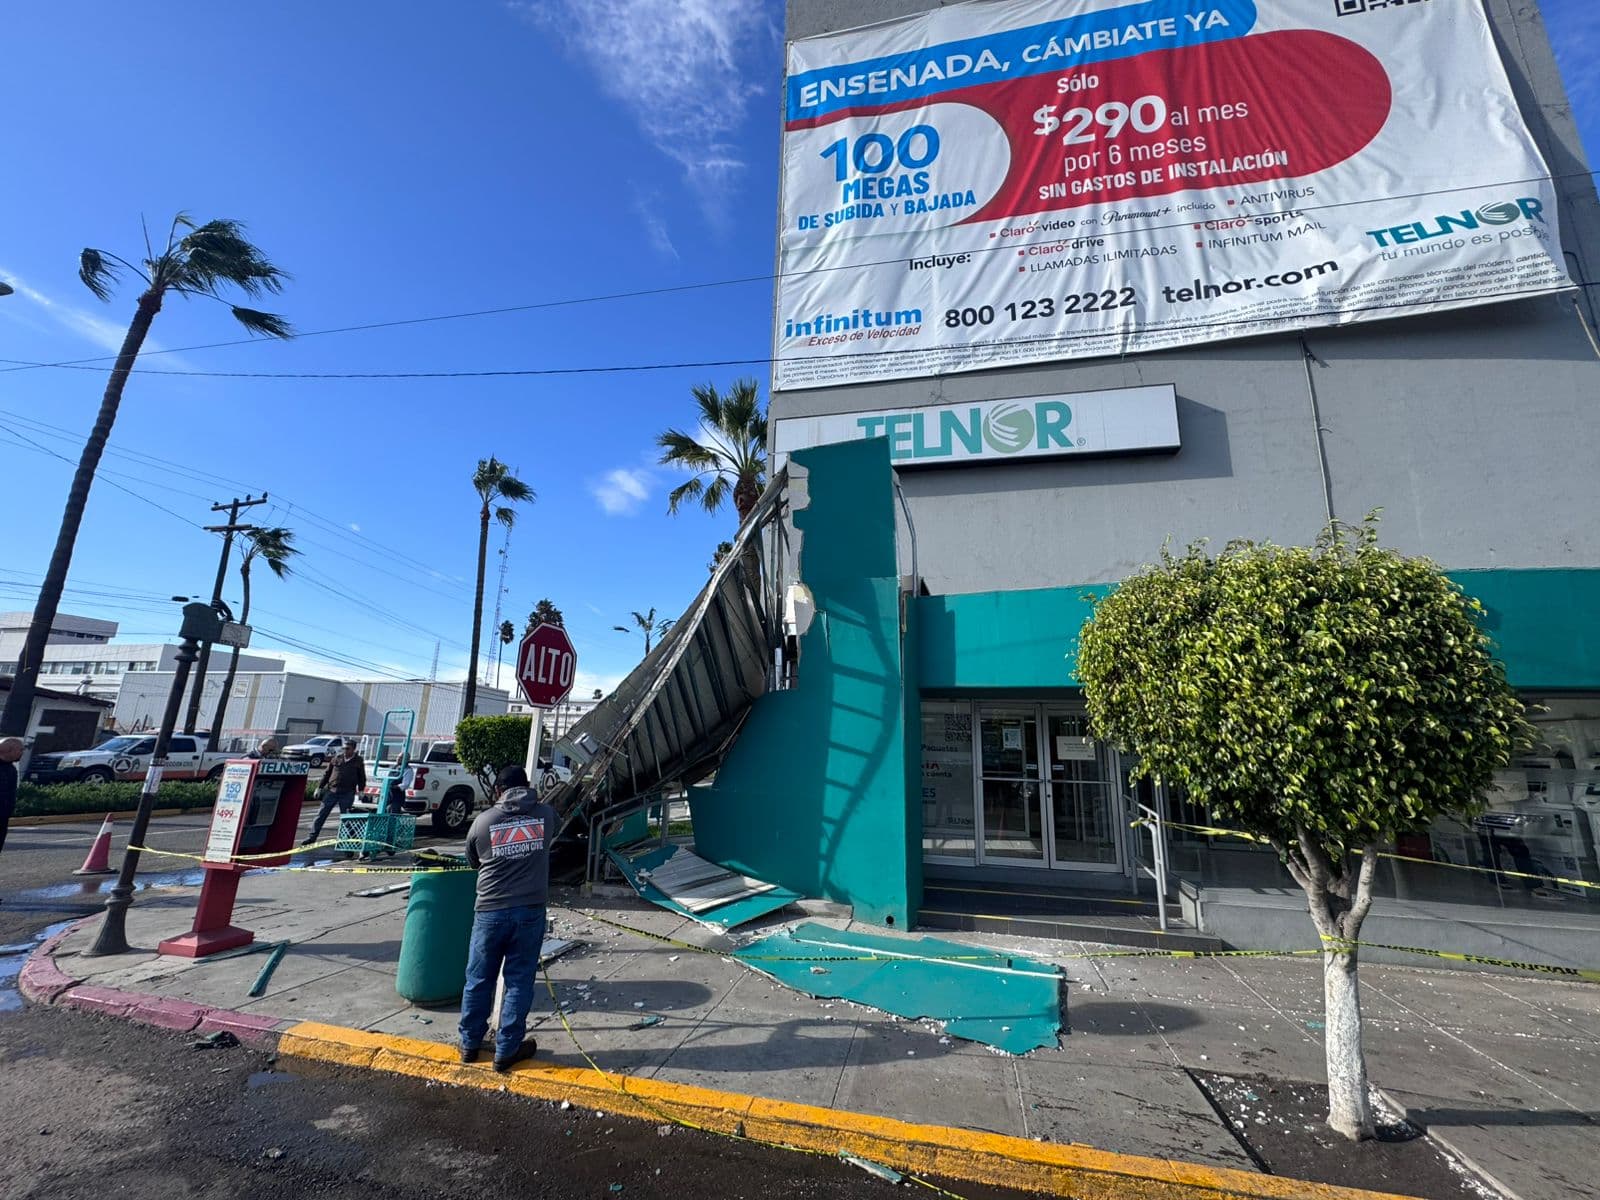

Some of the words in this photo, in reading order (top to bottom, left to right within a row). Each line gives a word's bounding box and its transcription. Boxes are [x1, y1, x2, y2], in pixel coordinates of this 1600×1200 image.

[799, 49, 1011, 108] ENSENADA,
[1021, 17, 1177, 63] CÁMBIATE
[1184, 9, 1230, 33] YA
[1056, 72, 1099, 94] Sólo
[1033, 94, 1168, 146] $290
[1171, 106, 1189, 126] al
[1198, 101, 1249, 123] mes
[819, 123, 941, 182] 100
[1064, 152, 1100, 177] por
[1108, 143, 1122, 164] 6
[1129, 134, 1207, 162] meses
[841, 171, 931, 205] MEGAS
[1038, 181, 1068, 200] SIN
[1071, 174, 1136, 196] GASTOS
[1140, 168, 1163, 186] DE
[1169, 149, 1289, 180] INSTALACIÓN
[798, 214, 819, 231] DE
[825, 202, 884, 227] SUBIDA
[890, 203, 899, 216] Y
[904, 189, 977, 215] BAJADA
[1080, 216, 1098, 227] con
[1100, 205, 1173, 227] Paramount+
[1176, 200, 1217, 212] incluido
[1240, 186, 1316, 206] ANTIVIRUS
[1208, 232, 1284, 250] INFINITUM
[1287, 221, 1327, 241] MAIL
[1366, 197, 1546, 248] TELNOR
[909, 252, 972, 271] Incluye:
[1030, 253, 1099, 273] LLAMADAS
[1103, 245, 1178, 263] ILIMITADAS
[1380, 248, 1398, 261] tu
[1403, 237, 1465, 257] mundo
[1471, 232, 1493, 246] es
[1162, 258, 1340, 304] telnor.com
[785, 307, 923, 338] infinitum
[945, 305, 995, 328] 800
[1004, 297, 1055, 322] 123
[1064, 286, 1137, 315] 2222
[808, 334, 848, 348] Exceso
[849, 330, 864, 342] de
[866, 324, 922, 340] Velocidad
[857, 400, 1075, 460] TELNOR
[521, 643, 573, 687] ALTO
[260, 760, 308, 775] TELNOR
